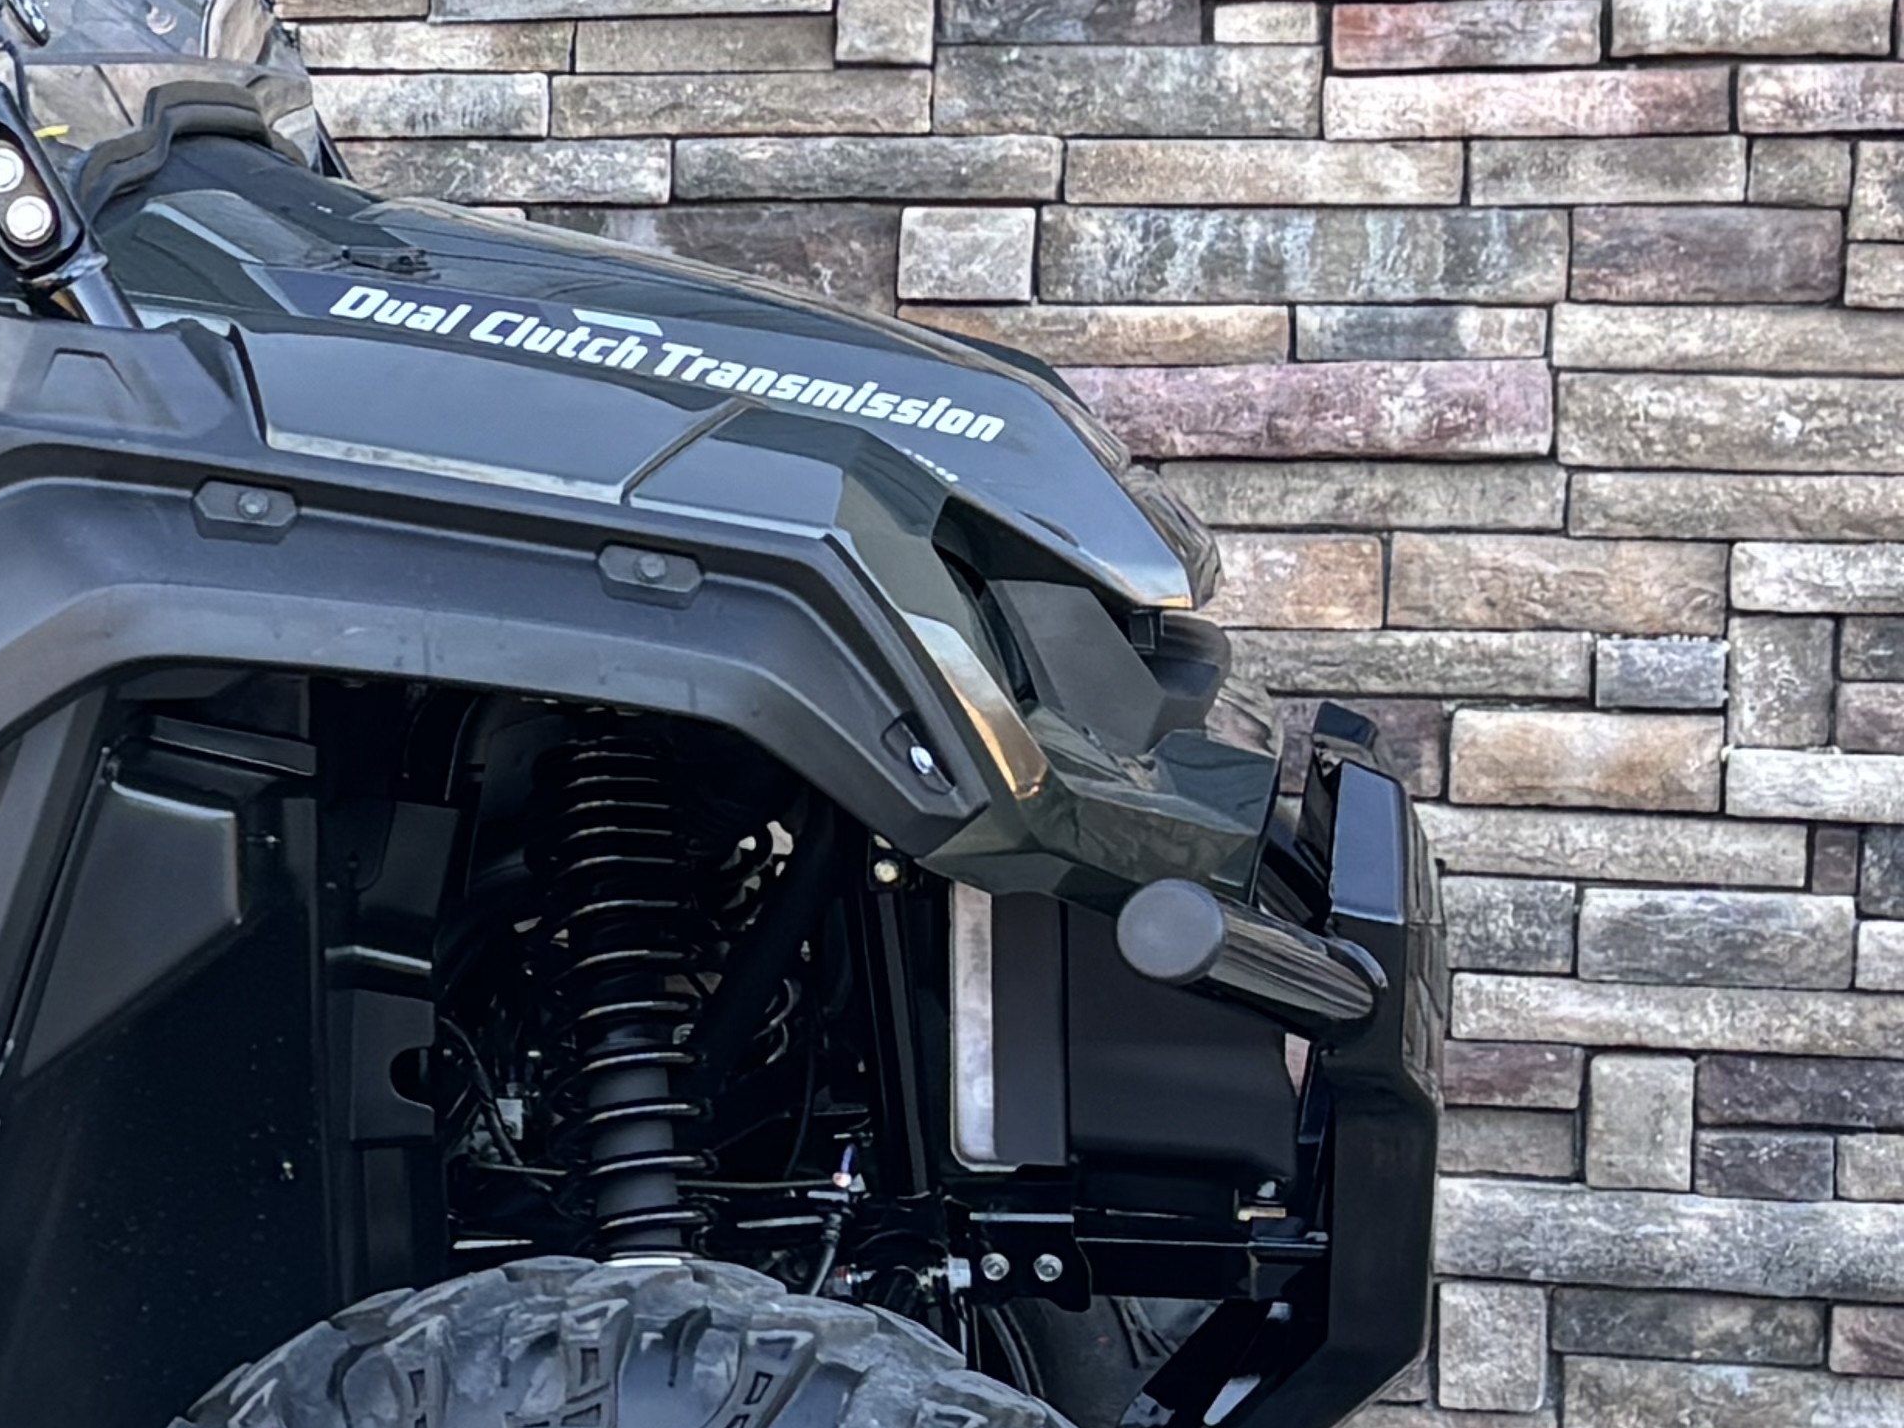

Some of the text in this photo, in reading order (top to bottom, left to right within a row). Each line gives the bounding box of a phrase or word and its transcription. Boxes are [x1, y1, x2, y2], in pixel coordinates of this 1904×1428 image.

[330, 284, 1006, 444] Dual Clutch Transmission
